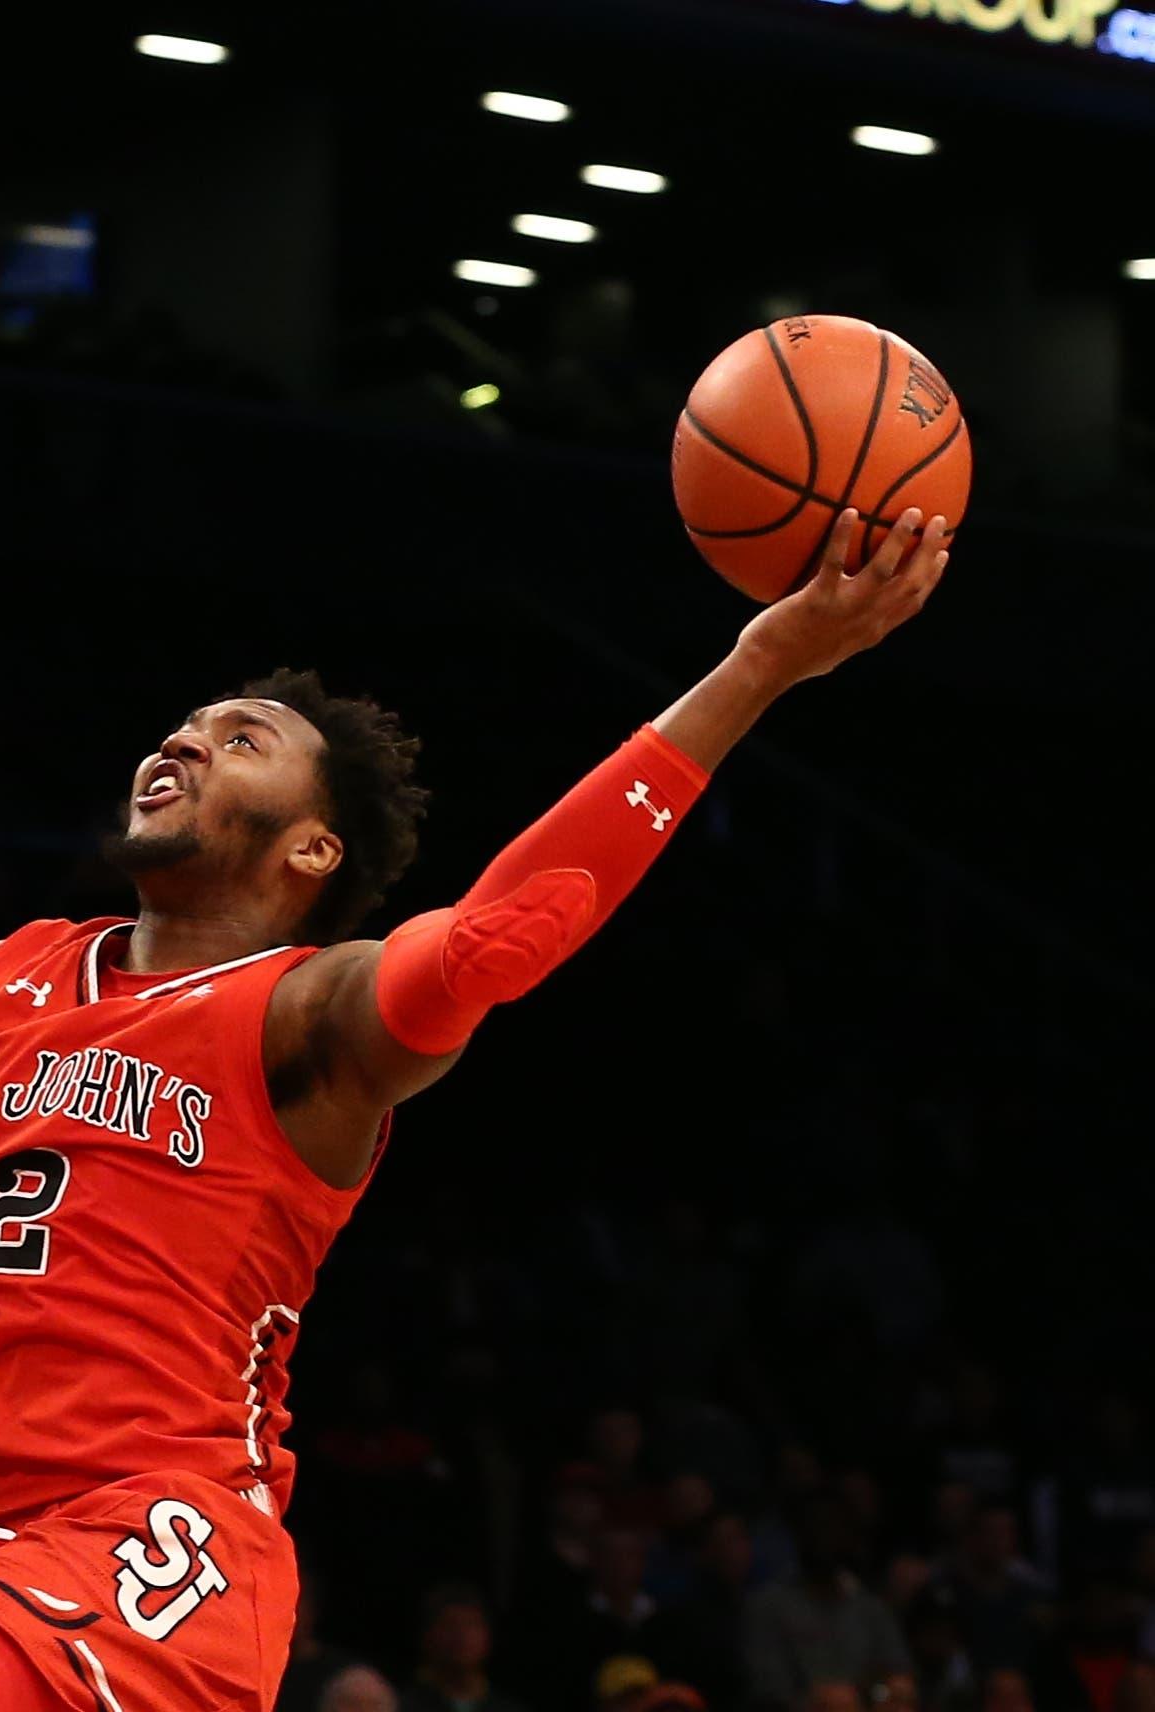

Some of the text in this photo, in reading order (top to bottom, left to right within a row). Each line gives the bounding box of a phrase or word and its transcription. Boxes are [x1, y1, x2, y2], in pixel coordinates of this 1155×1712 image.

[857, 0, 1119, 48] OUP
[899, 356, 951, 429] OCK
[2, 1047, 212, 1168] JOHN'S
